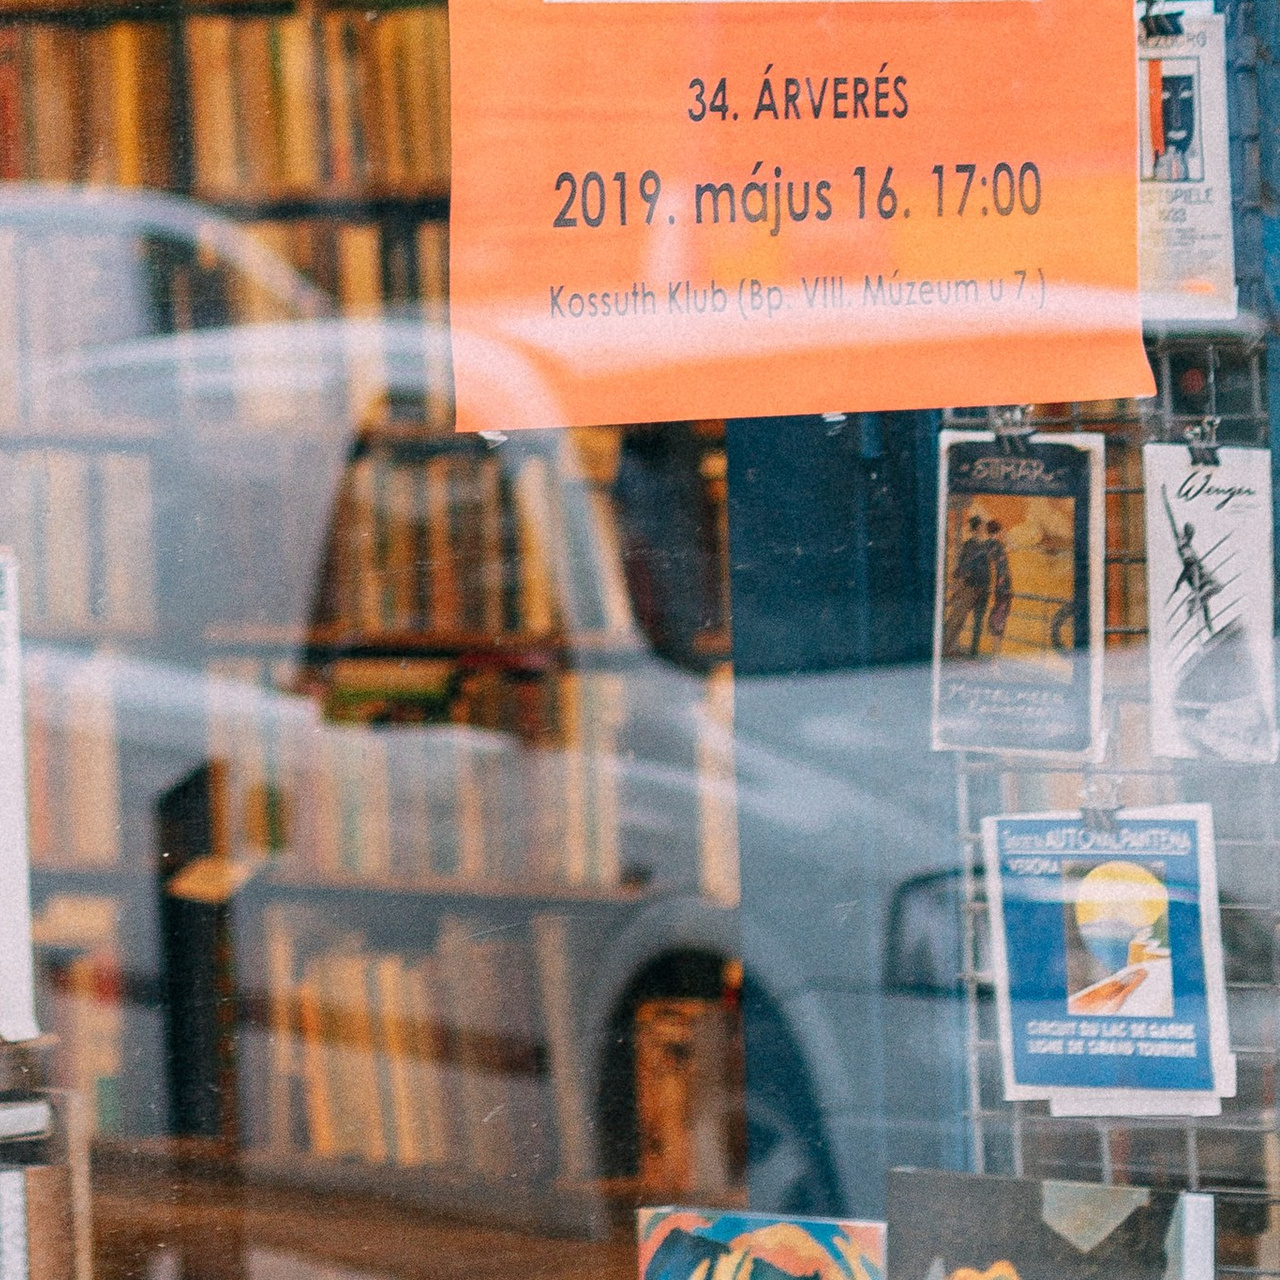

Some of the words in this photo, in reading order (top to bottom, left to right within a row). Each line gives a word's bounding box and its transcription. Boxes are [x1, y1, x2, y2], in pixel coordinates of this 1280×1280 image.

[688, 77, 739, 122] 34.
[754, 62, 909, 121] ÁRVERÉS
[552, 169, 676, 228] 2019.
[695, 160, 832, 237] május
[853, 166, 911, 220] 16.
[932, 160, 1042, 218] 17:00
[549, 280, 656, 319] Kossuth
[667, 278, 727, 316] Klub
[737, 278, 790, 321] (Bp.
[801, 275, 852, 310] VIII.
[863, 269, 979, 308] Múzeum
[990, 277, 1005, 301] u
